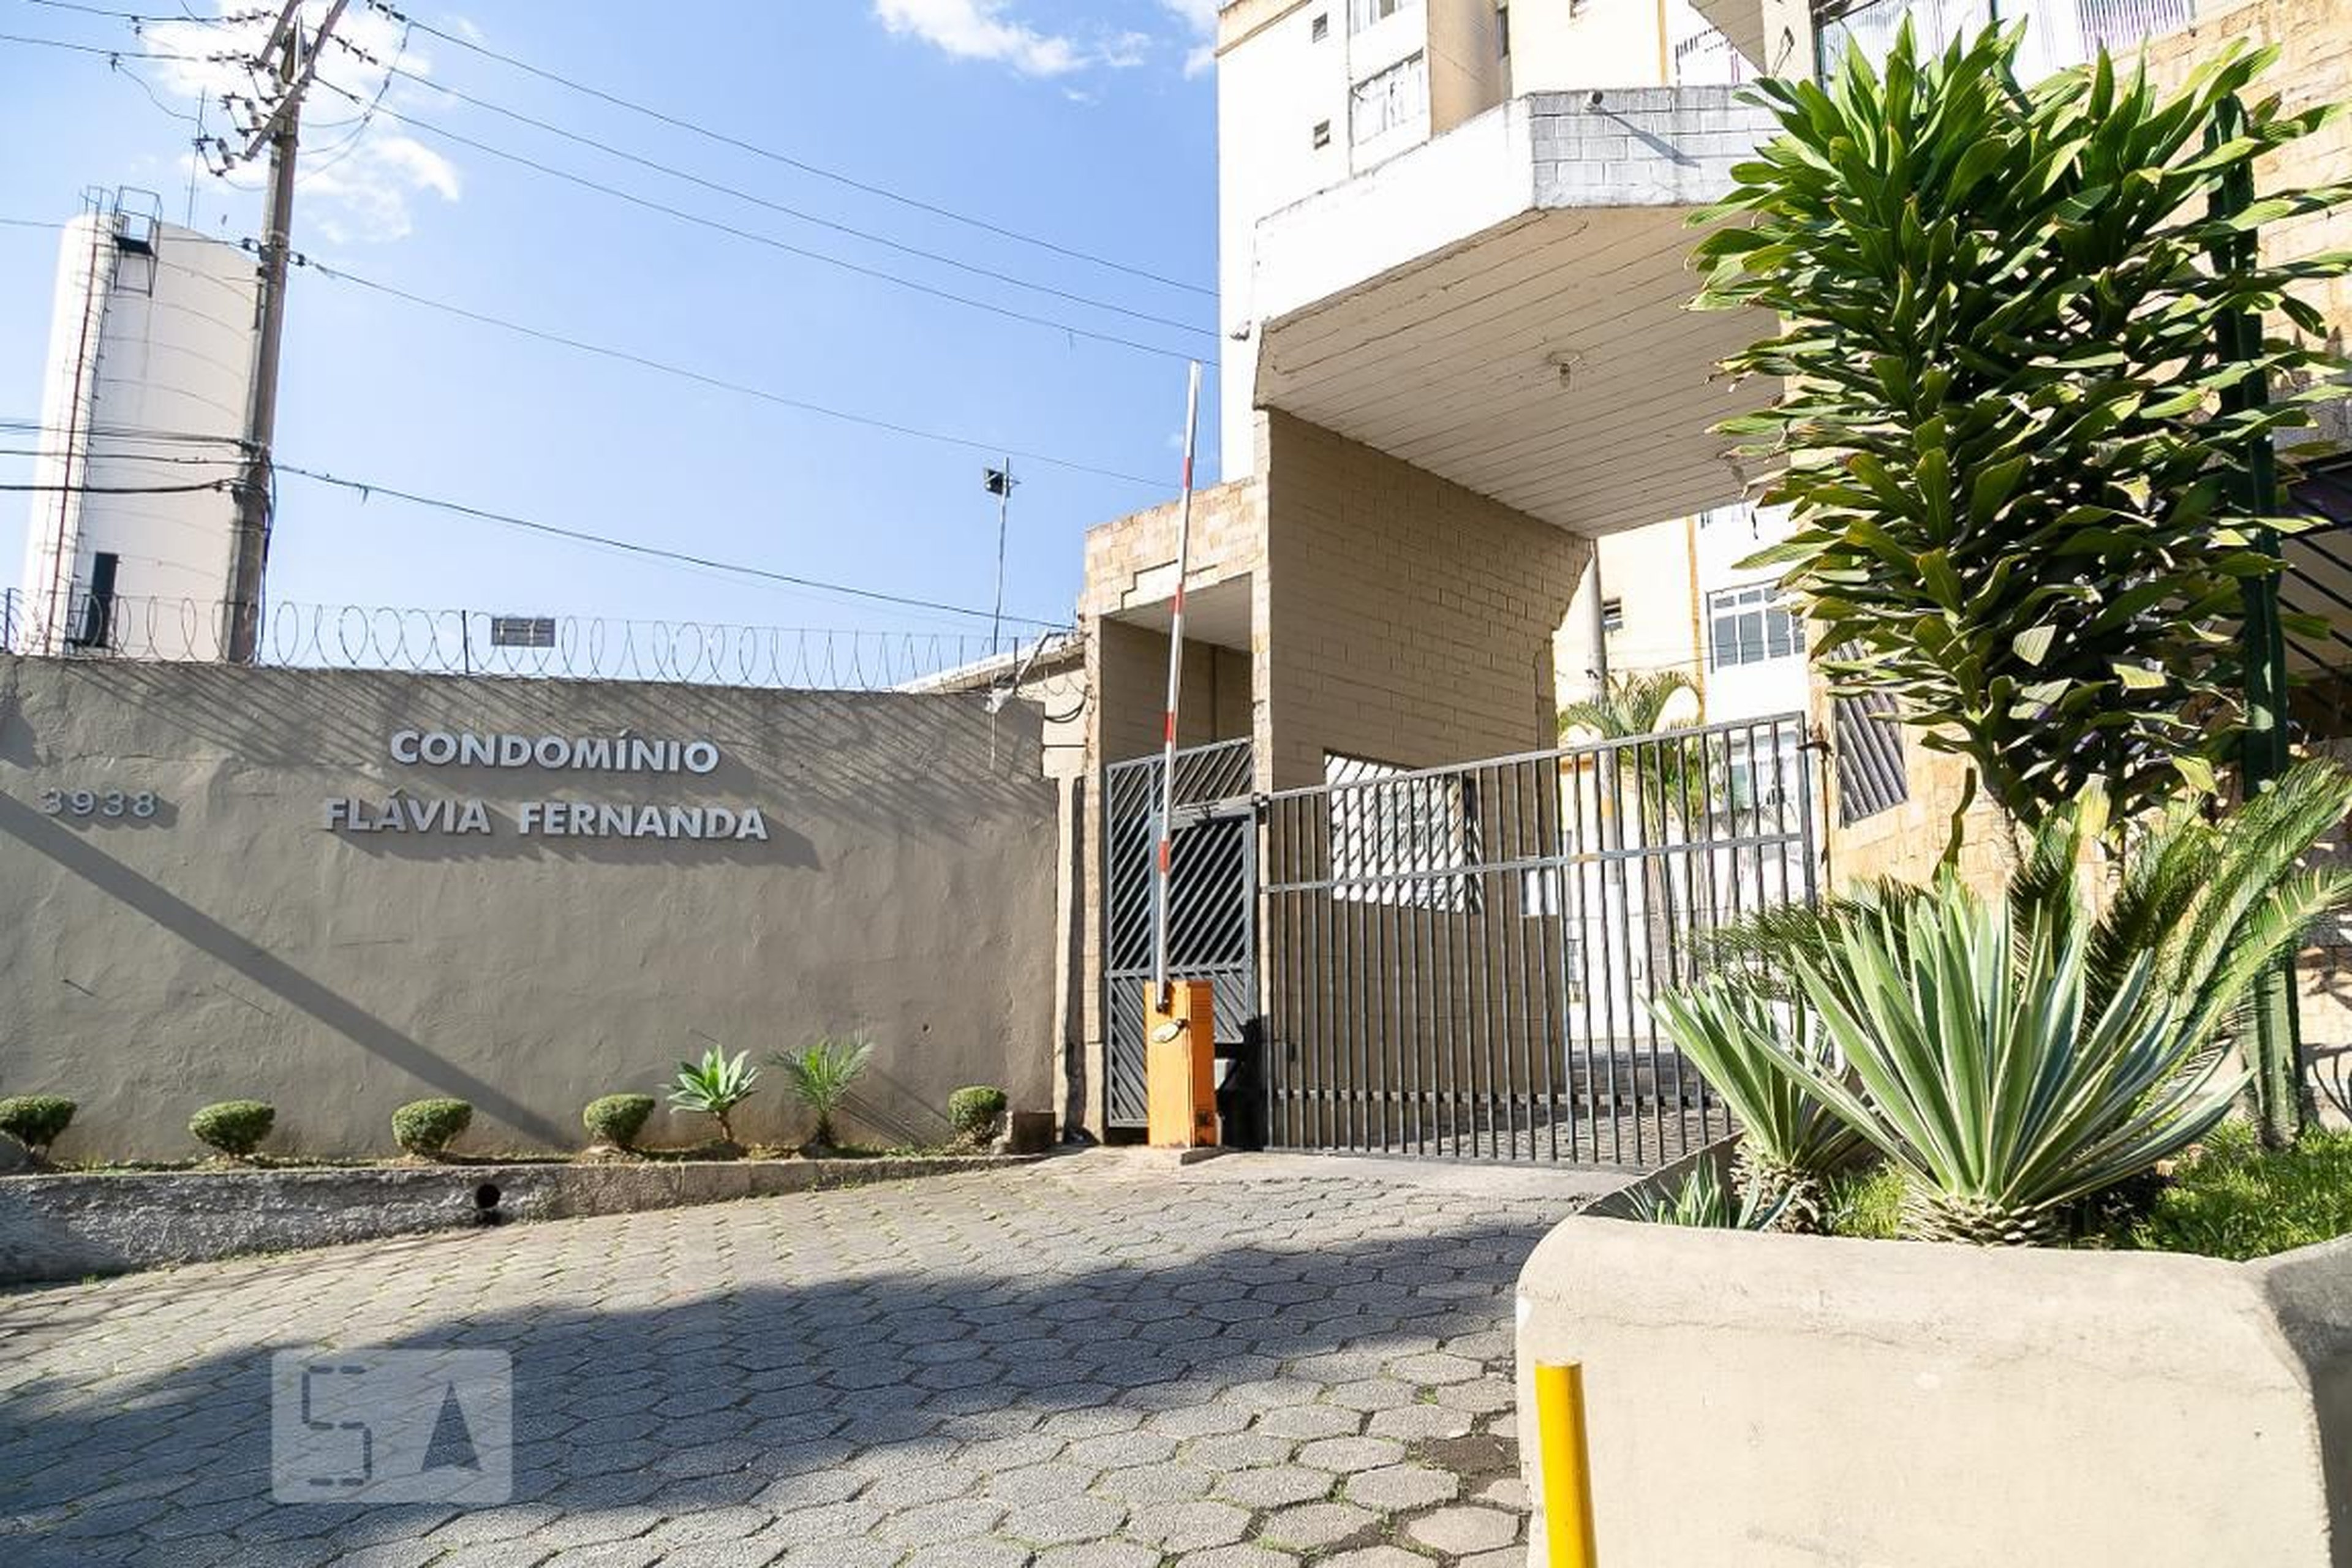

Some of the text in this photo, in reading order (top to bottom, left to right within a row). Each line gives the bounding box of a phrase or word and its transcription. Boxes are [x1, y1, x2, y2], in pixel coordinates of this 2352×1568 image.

[390, 729, 720, 774] CONDOMÍNIO
[42, 789, 156, 816] 3938
[324, 788, 769, 840] FLÁVIA FERNANDA
